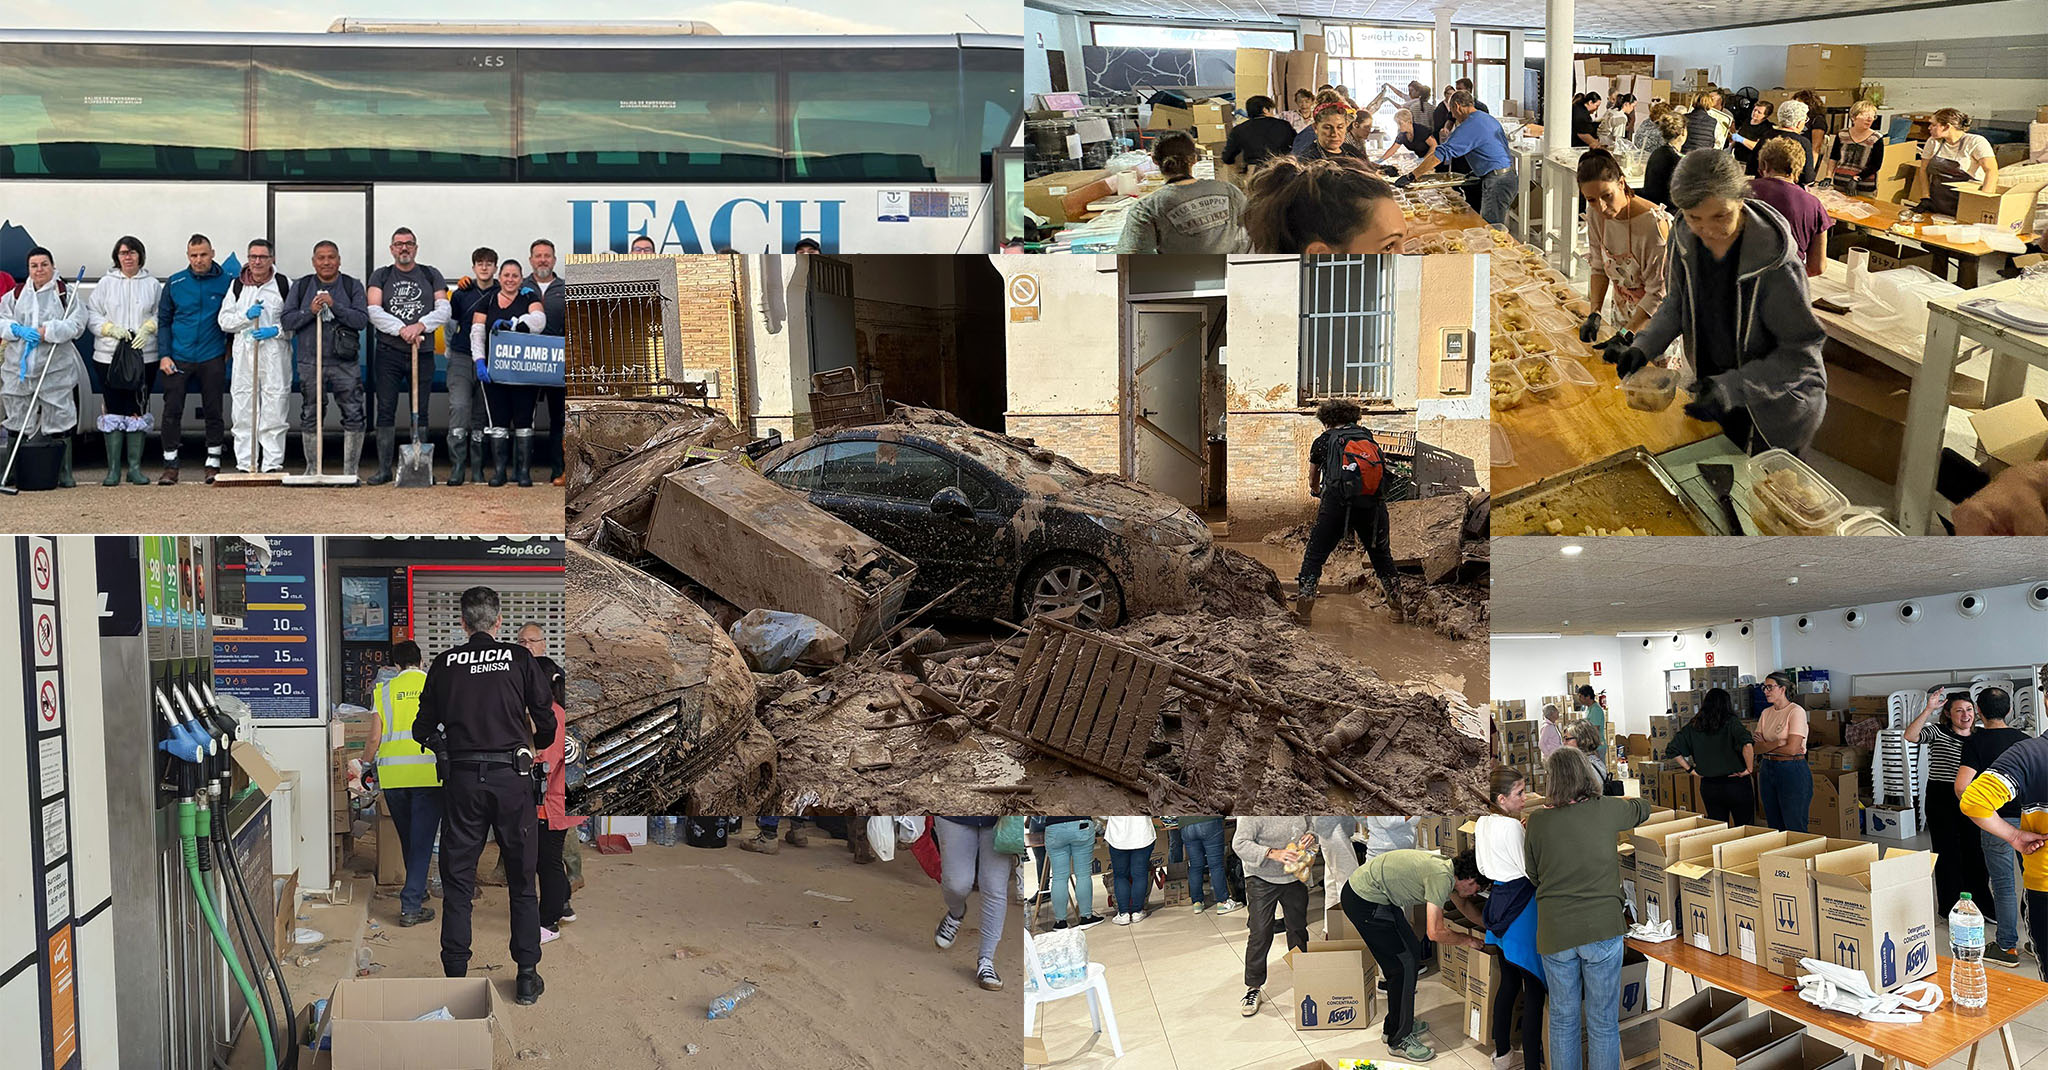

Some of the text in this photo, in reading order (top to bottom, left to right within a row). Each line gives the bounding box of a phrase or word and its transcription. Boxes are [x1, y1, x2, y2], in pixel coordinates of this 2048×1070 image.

[495, 344, 522, 359] CALP
[523, 346, 549, 361] AMB
[494, 359, 559, 374] SOM SOLIDARITAT
[499, 545, 551, 557] Stop&Go
[149, 557, 161, 583] 98
[167, 563, 177, 587] 95
[280, 586, 289, 599] 5
[272, 618, 290, 631] 10
[274, 650, 291, 662] 15
[446, 649, 513, 667] POLICIA
[470, 662, 510, 674] BENISSA
[273, 683, 292, 695] 20
[1327, 1006, 1354, 1024] Asevi
